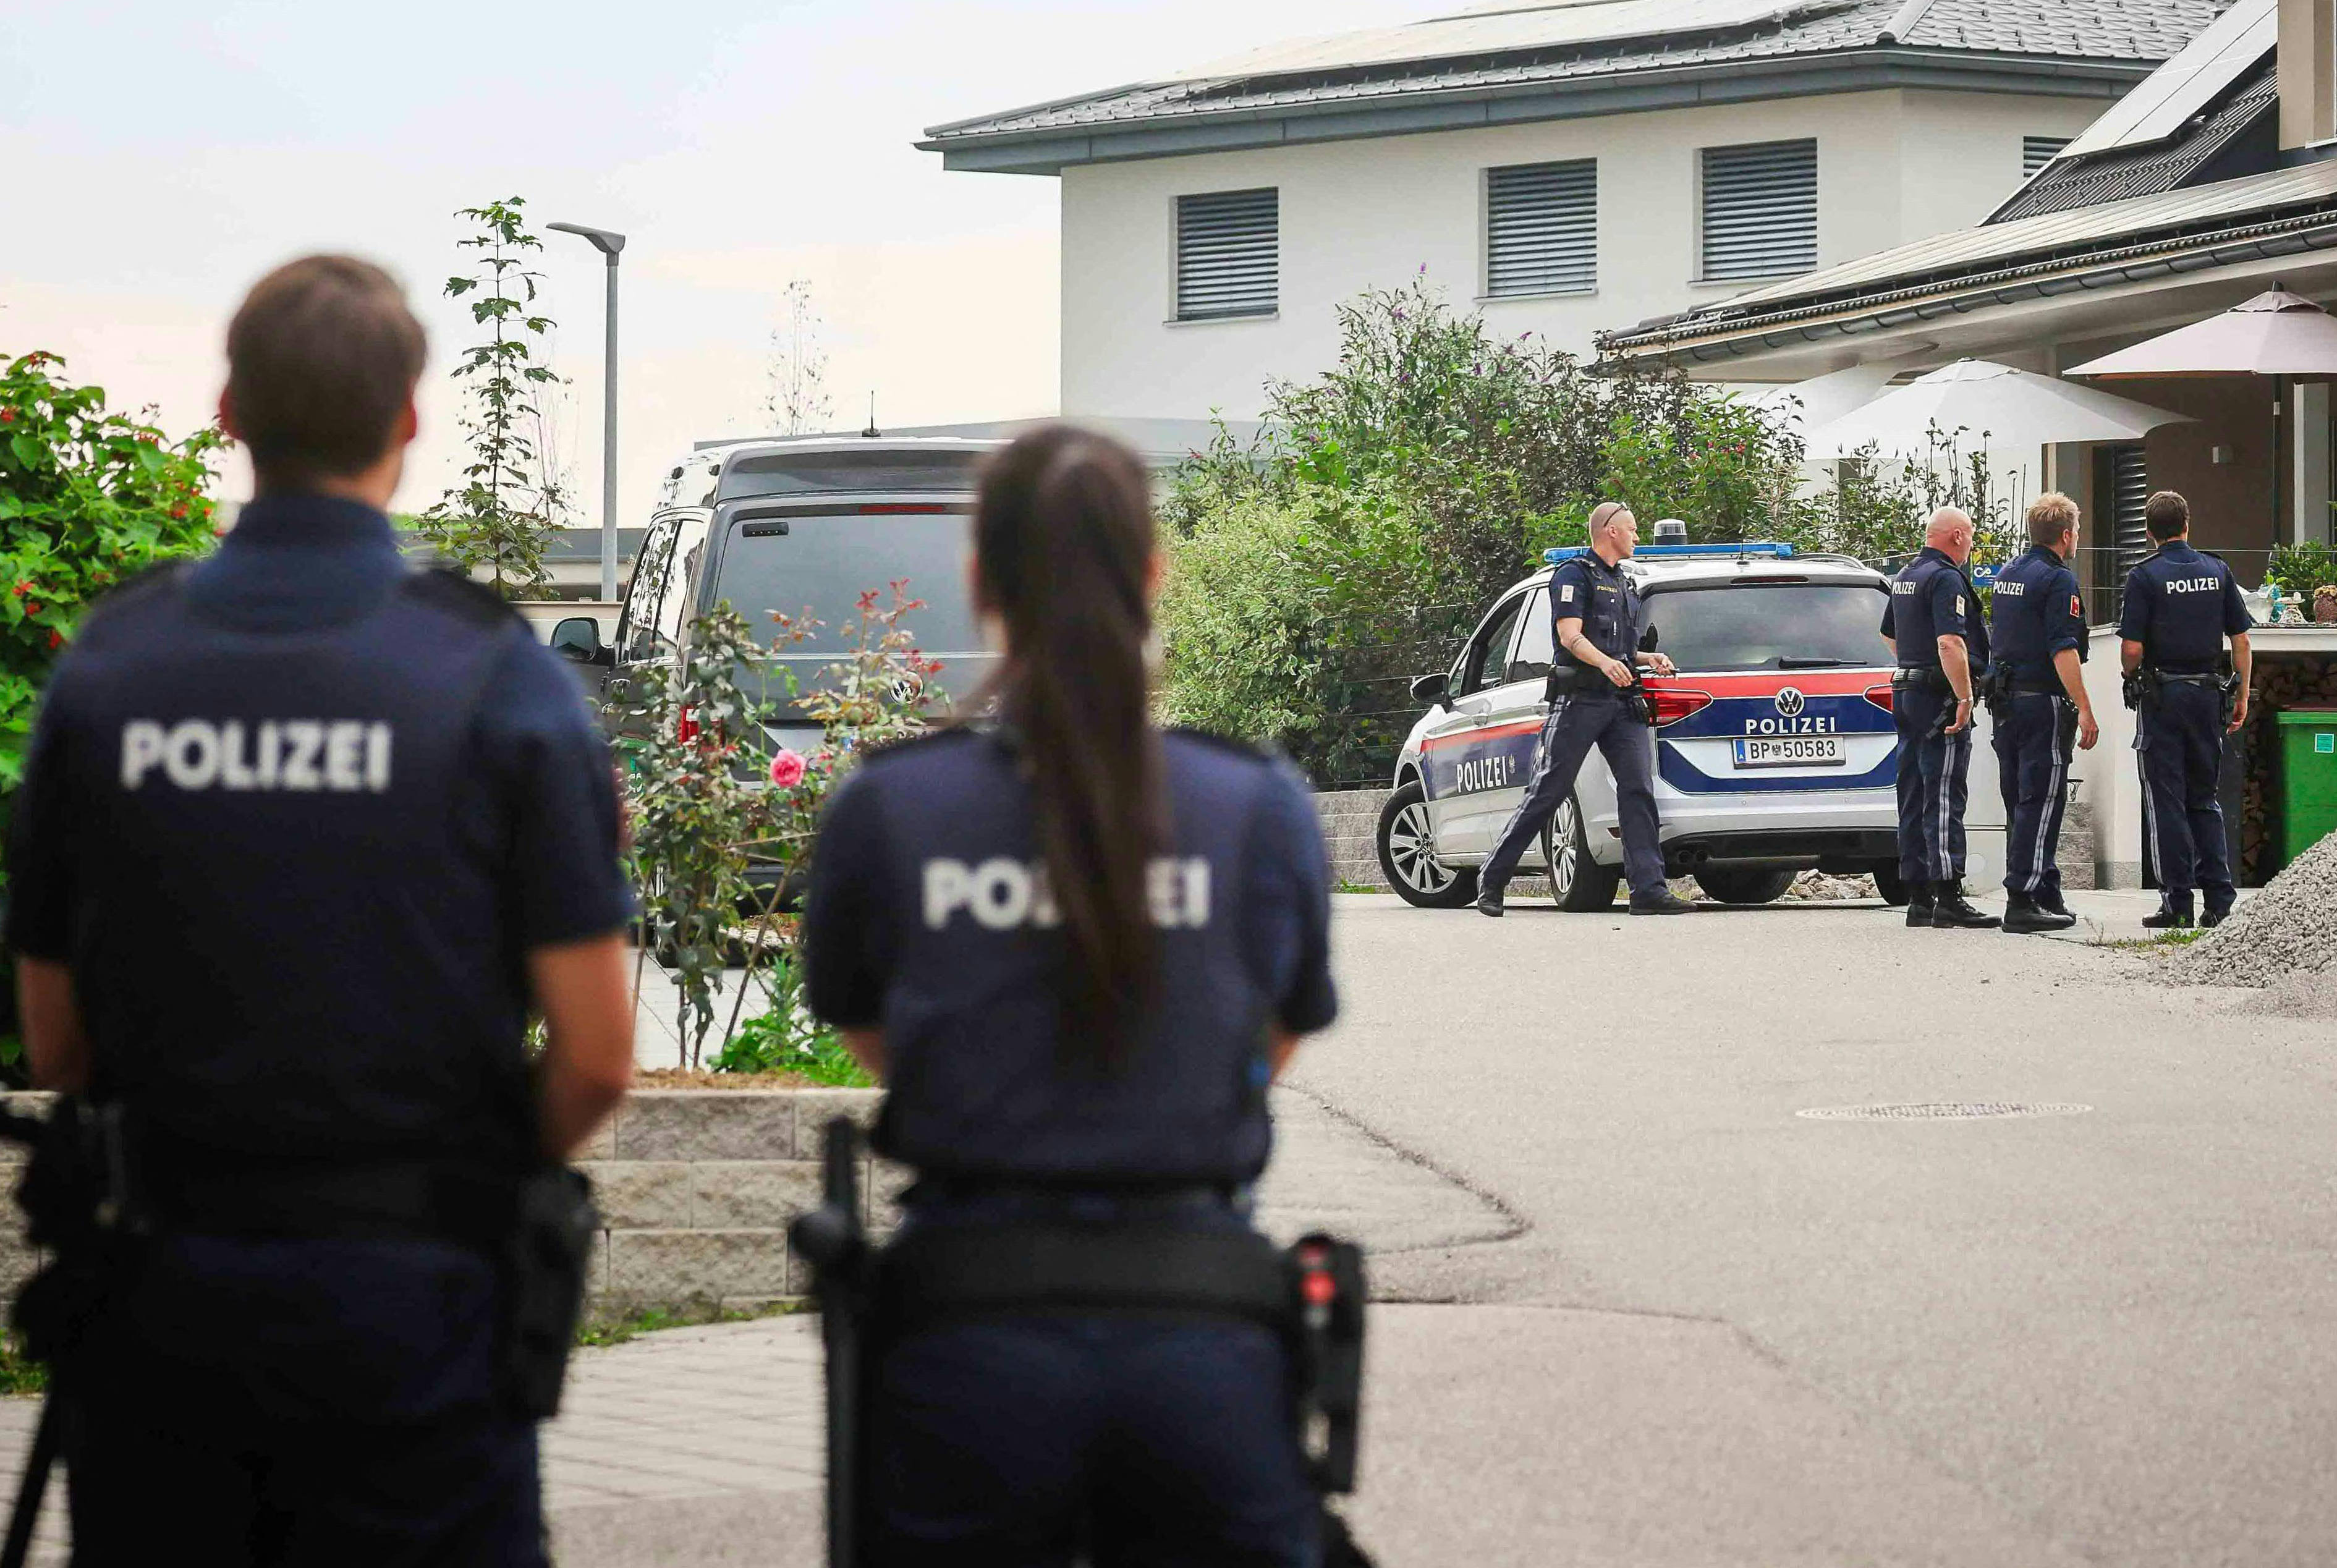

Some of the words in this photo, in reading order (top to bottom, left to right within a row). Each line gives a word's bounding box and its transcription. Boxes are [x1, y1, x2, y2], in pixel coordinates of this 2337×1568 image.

[1892, 581, 1916, 595] POLIZEI
[1993, 581, 2025, 596] POLIZEI
[2166, 577, 2219, 594] POLIZEI
[1745, 717, 1836, 734] POLIZEI
[122, 720, 392, 790] POLIZEI
[1456, 755, 1508, 793] POLIZEI
[923, 856, 1211, 928] POEI
